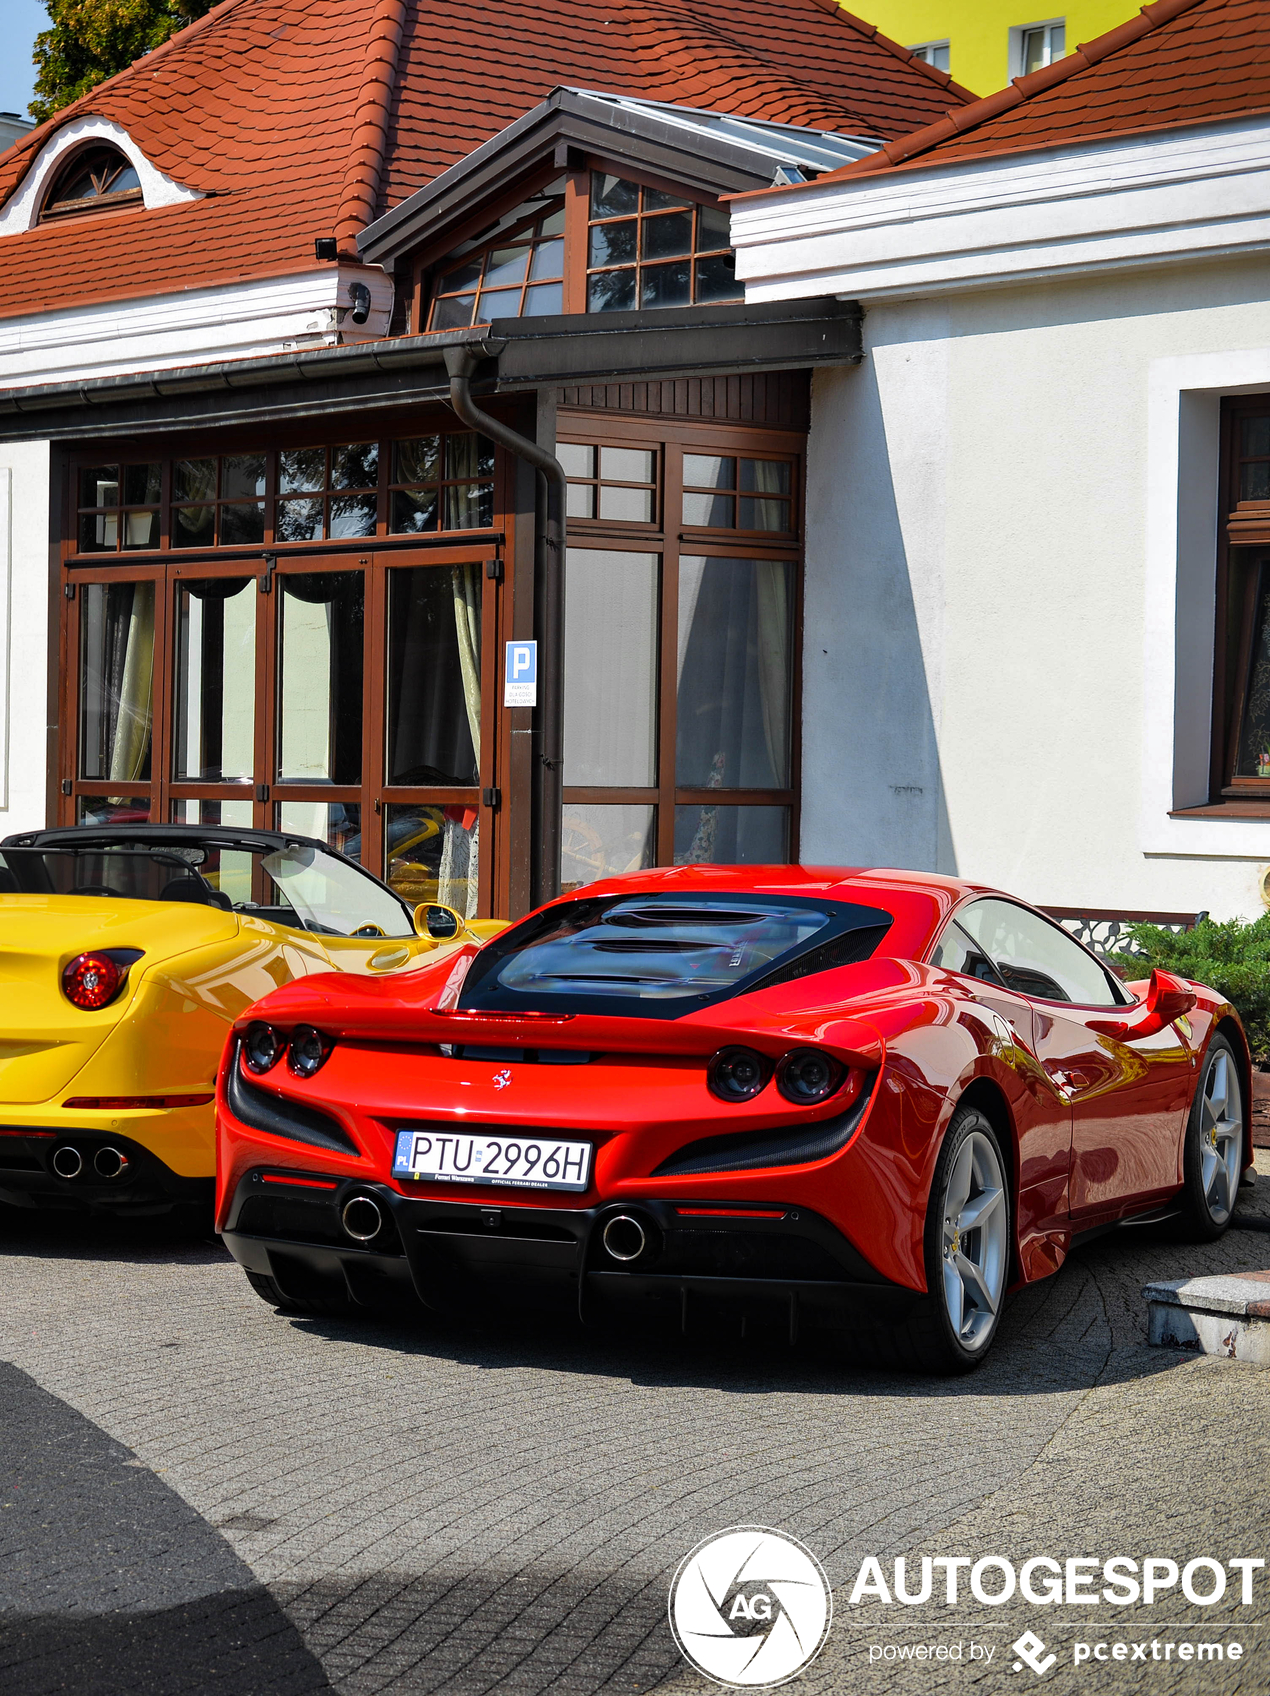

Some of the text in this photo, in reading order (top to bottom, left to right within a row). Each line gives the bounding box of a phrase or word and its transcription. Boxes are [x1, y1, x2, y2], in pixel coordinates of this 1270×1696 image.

[513, 647, 531, 679] P
[396, 1155, 409, 1166] PL
[412, 1136, 585, 1181] PTU 2996H
